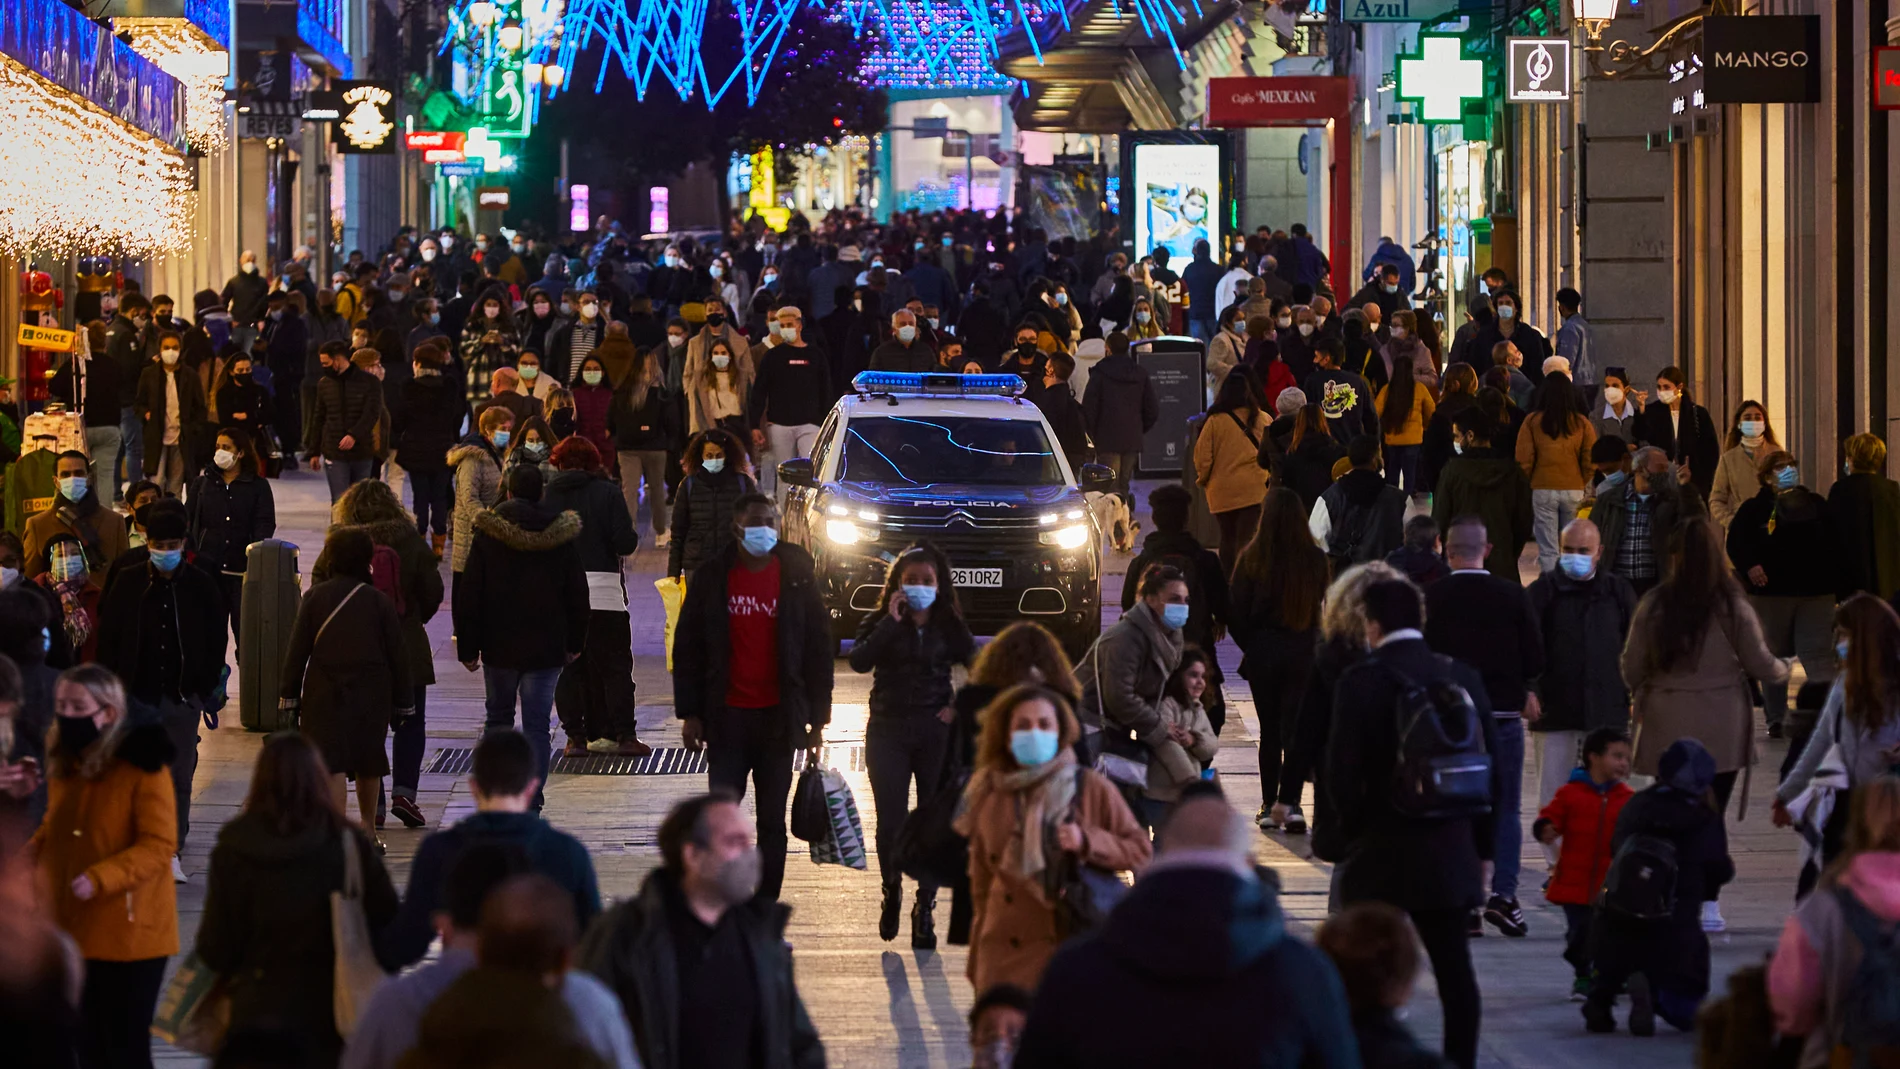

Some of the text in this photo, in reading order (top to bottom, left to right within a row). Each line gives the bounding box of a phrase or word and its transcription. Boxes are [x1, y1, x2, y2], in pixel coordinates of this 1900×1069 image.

[1353, 0, 1410, 18] Azul
[1715, 51, 1809, 68] MANGO
[1260, 90, 1316, 104] MEXICANA
[246, 117, 293, 135] REYES
[35, 331, 68, 343] ONCE
[914, 500, 1012, 508] POLICIA
[951, 570, 1001, 585] 2610RZ
